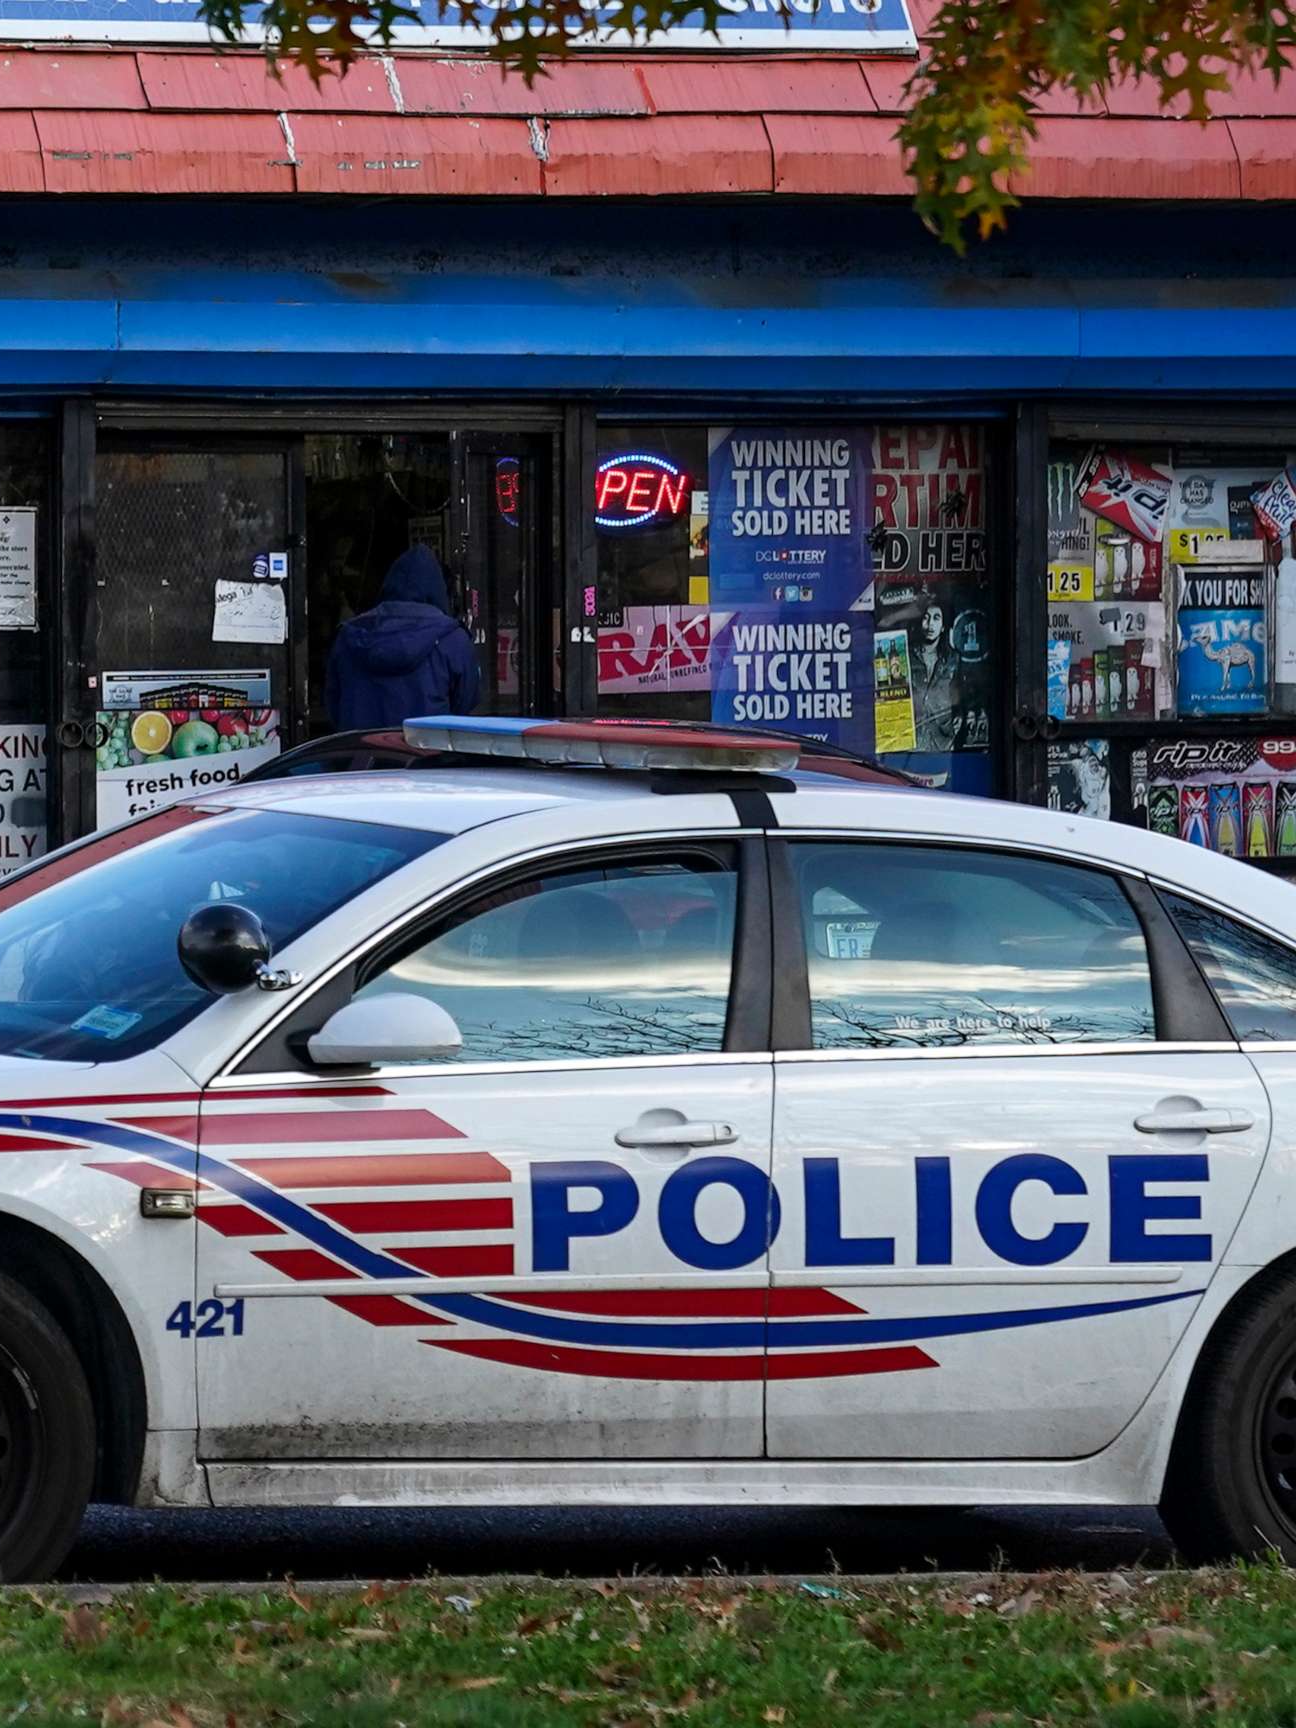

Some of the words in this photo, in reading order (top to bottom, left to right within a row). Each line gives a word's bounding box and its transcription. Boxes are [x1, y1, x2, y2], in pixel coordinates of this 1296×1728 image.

[731, 438, 850, 469] WINNING
[731, 469, 850, 509] TICKET
[731, 509, 788, 536] SOLD
[794, 509, 851, 536] HERE
[1195, 580, 1223, 606] YOU
[1225, 580, 1248, 606] FOR
[732, 622, 852, 652] WINNING
[732, 652, 852, 693] TICKET
[732, 694, 790, 722] SOLD
[796, 692, 853, 721] HERE
[125, 772, 184, 797] fresh
[894, 1014, 923, 1031] We
[926, 1017, 950, 1031] are
[956, 1014, 991, 1031] here
[996, 1015, 1014, 1030] to
[1017, 1014, 1051, 1033] help
[530, 1153, 1213, 1273] POLICE
[165, 1298, 246, 1338] 421
